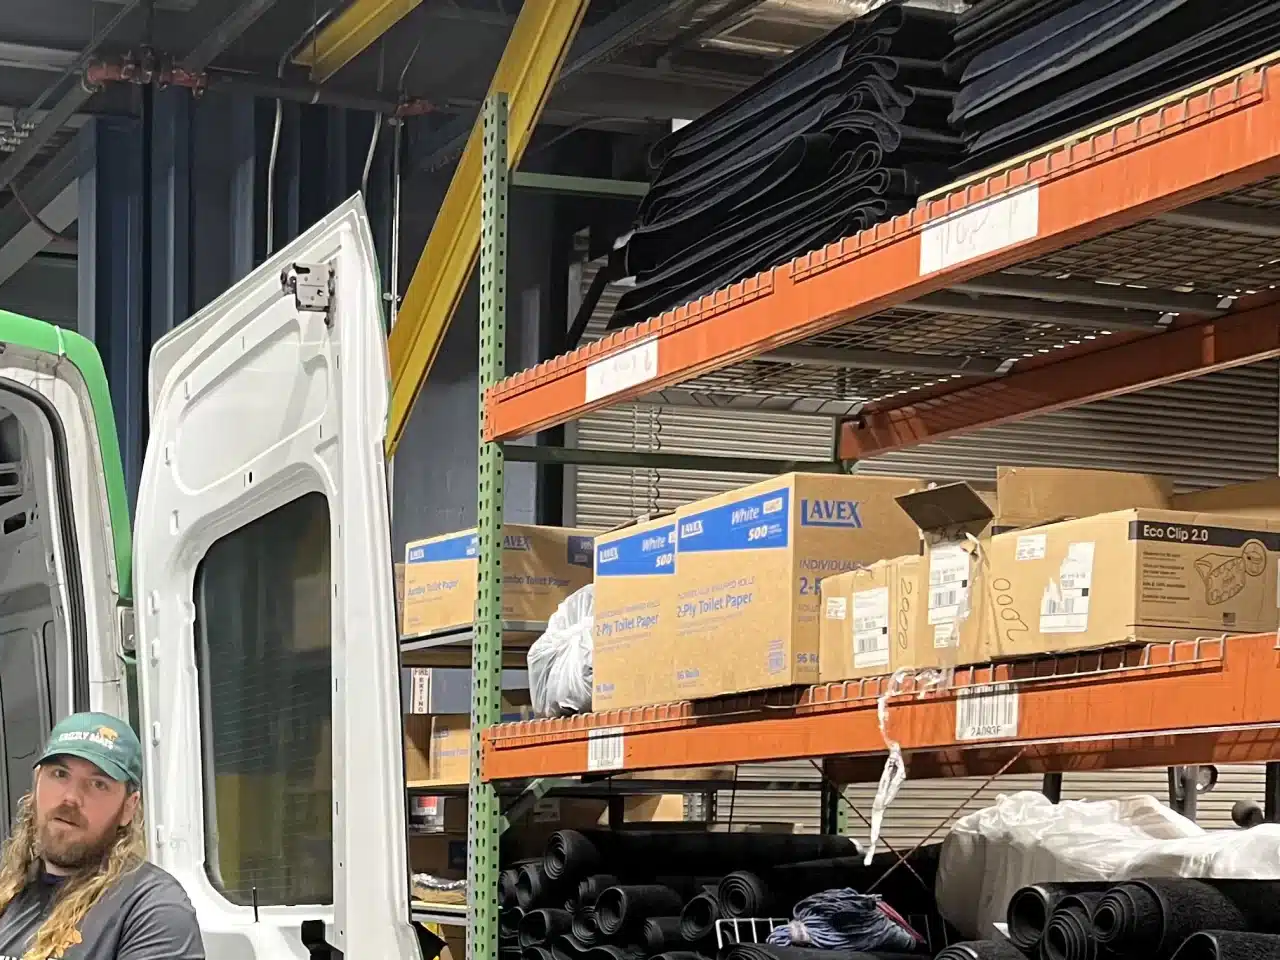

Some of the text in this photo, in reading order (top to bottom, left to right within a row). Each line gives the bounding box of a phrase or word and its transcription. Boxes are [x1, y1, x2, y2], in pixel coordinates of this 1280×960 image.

[681, 520, 704, 539] LAVEX
[731, 507, 759, 525] White
[801, 499, 862, 529] LAVEX
[747, 525, 768, 542] 500
[1143, 524, 1209, 542] Eco Clip 2.0
[503, 536, 533, 551] AVEX
[642, 535, 666, 552] White
[655, 553, 672, 568] 500
[698, 596, 724, 614] Toilet
[725, 592, 753, 610] Paper
[614, 617, 635, 633] Toilet
[636, 612, 659, 629] Paper
